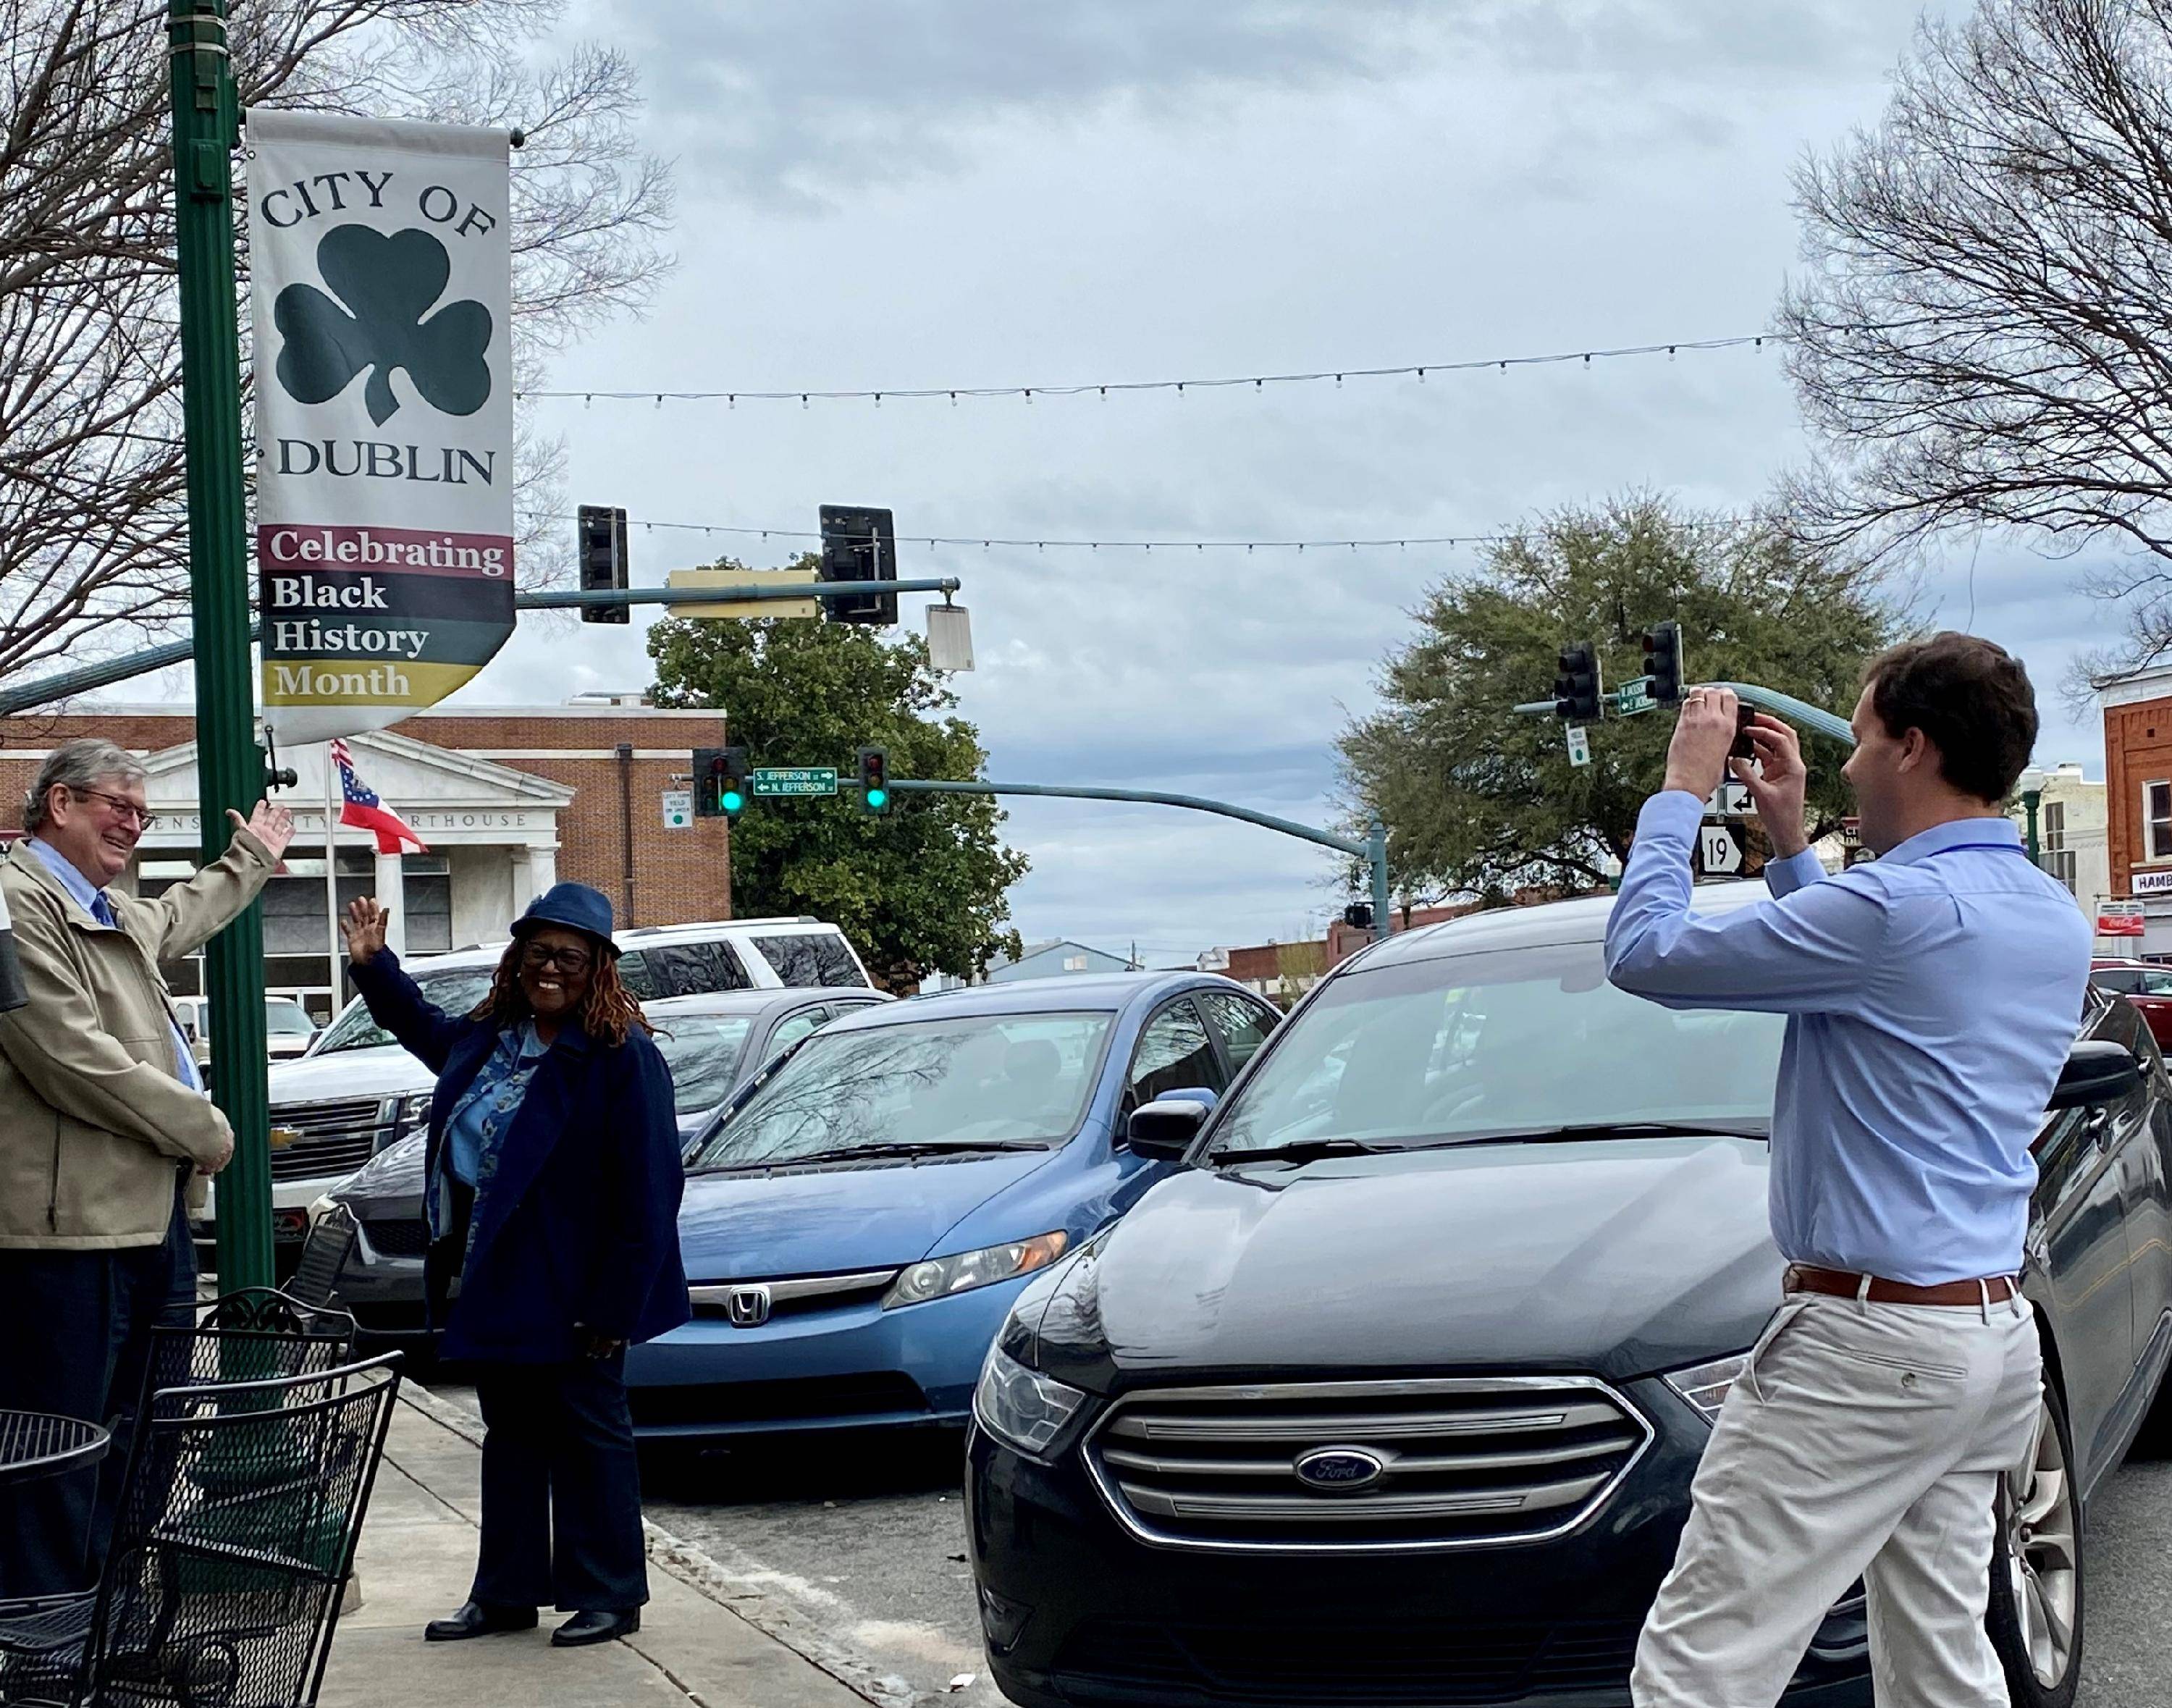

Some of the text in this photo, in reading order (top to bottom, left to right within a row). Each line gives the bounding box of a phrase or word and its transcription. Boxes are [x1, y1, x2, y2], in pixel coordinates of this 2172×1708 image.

[261, 170, 495, 237] CITY OF
[277, 438, 495, 487] DUBLIN
[270, 530, 505, 577] Celebrating
[272, 576, 389, 608] Black
[273, 618, 430, 659] History
[274, 665, 411, 696] Month
[767, 771, 811, 780] JEFFERSON
[782, 783, 825, 791] JEFFERSON
[411, 814, 526, 827] RTHOUSE
[1709, 837, 1727, 865] 19
[1316, 1459, 1358, 1478] Ford
